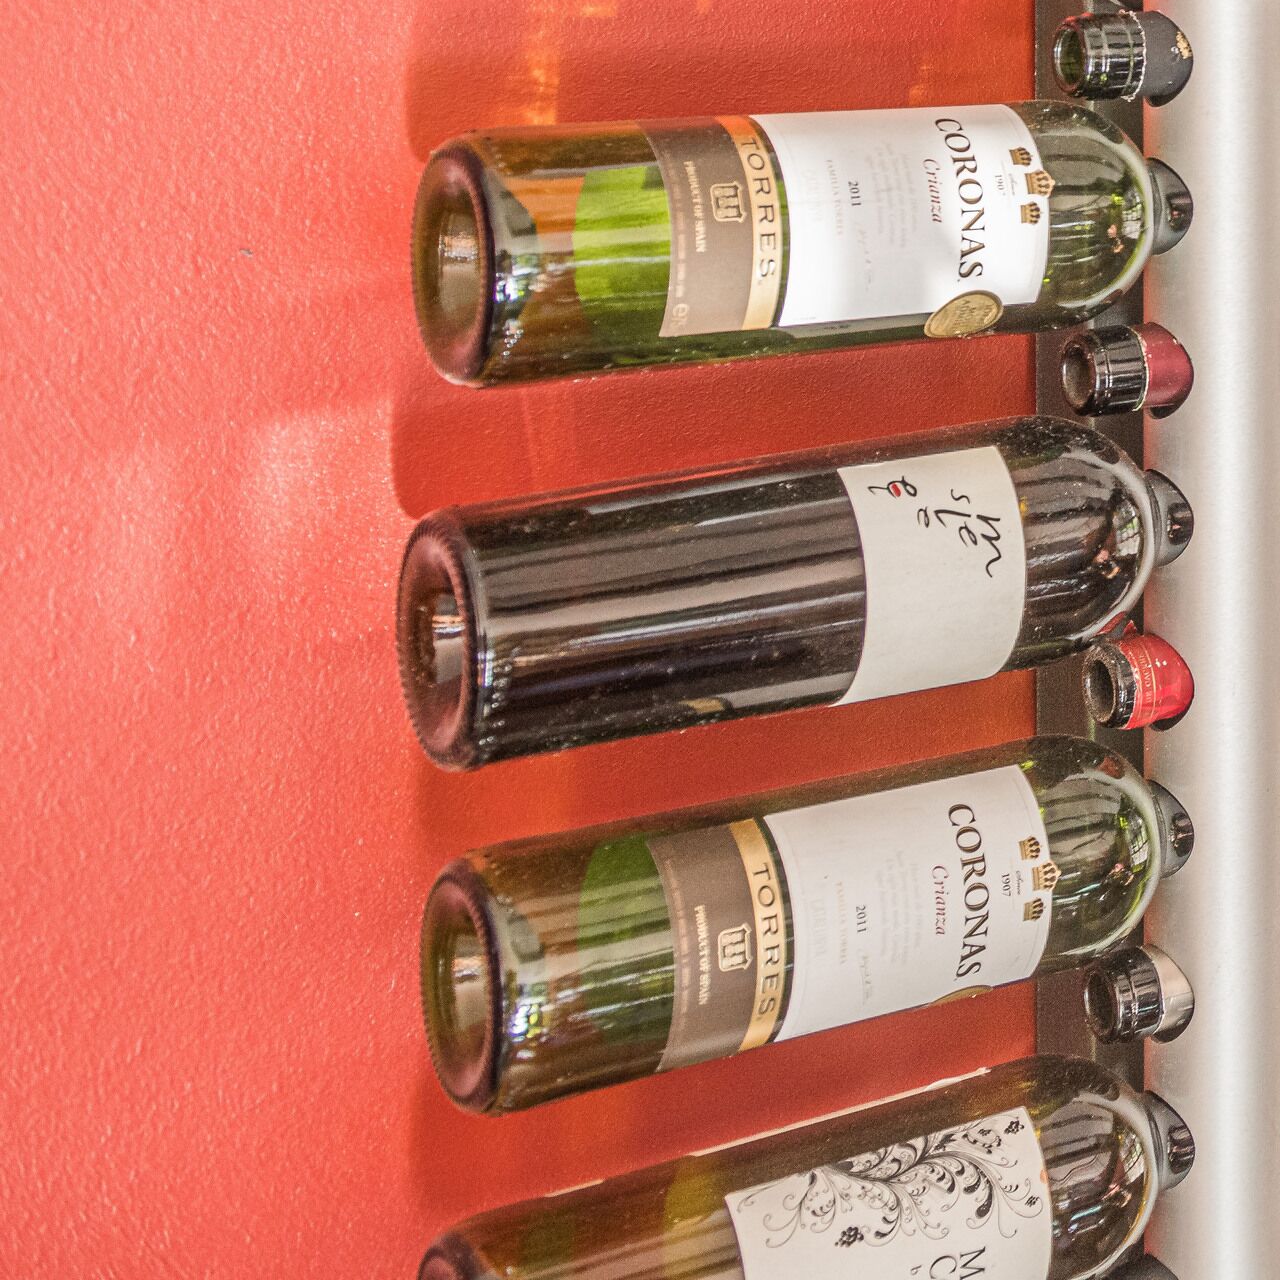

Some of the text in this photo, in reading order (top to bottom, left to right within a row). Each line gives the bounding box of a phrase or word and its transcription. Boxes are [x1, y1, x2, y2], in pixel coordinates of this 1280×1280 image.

[739, 137, 778, 279] TORRES
[846, 179, 862, 207] 2011
[921, 157, 944, 224] Crianza
[933, 117, 986, 282] CORONAS
[853, 903, 868, 934] 2011
[929, 864, 950, 936] Crianza
[947, 803, 990, 979] CORONAS
[999, 872, 1012, 898] 1907
[750, 860, 779, 1017] TORRES
